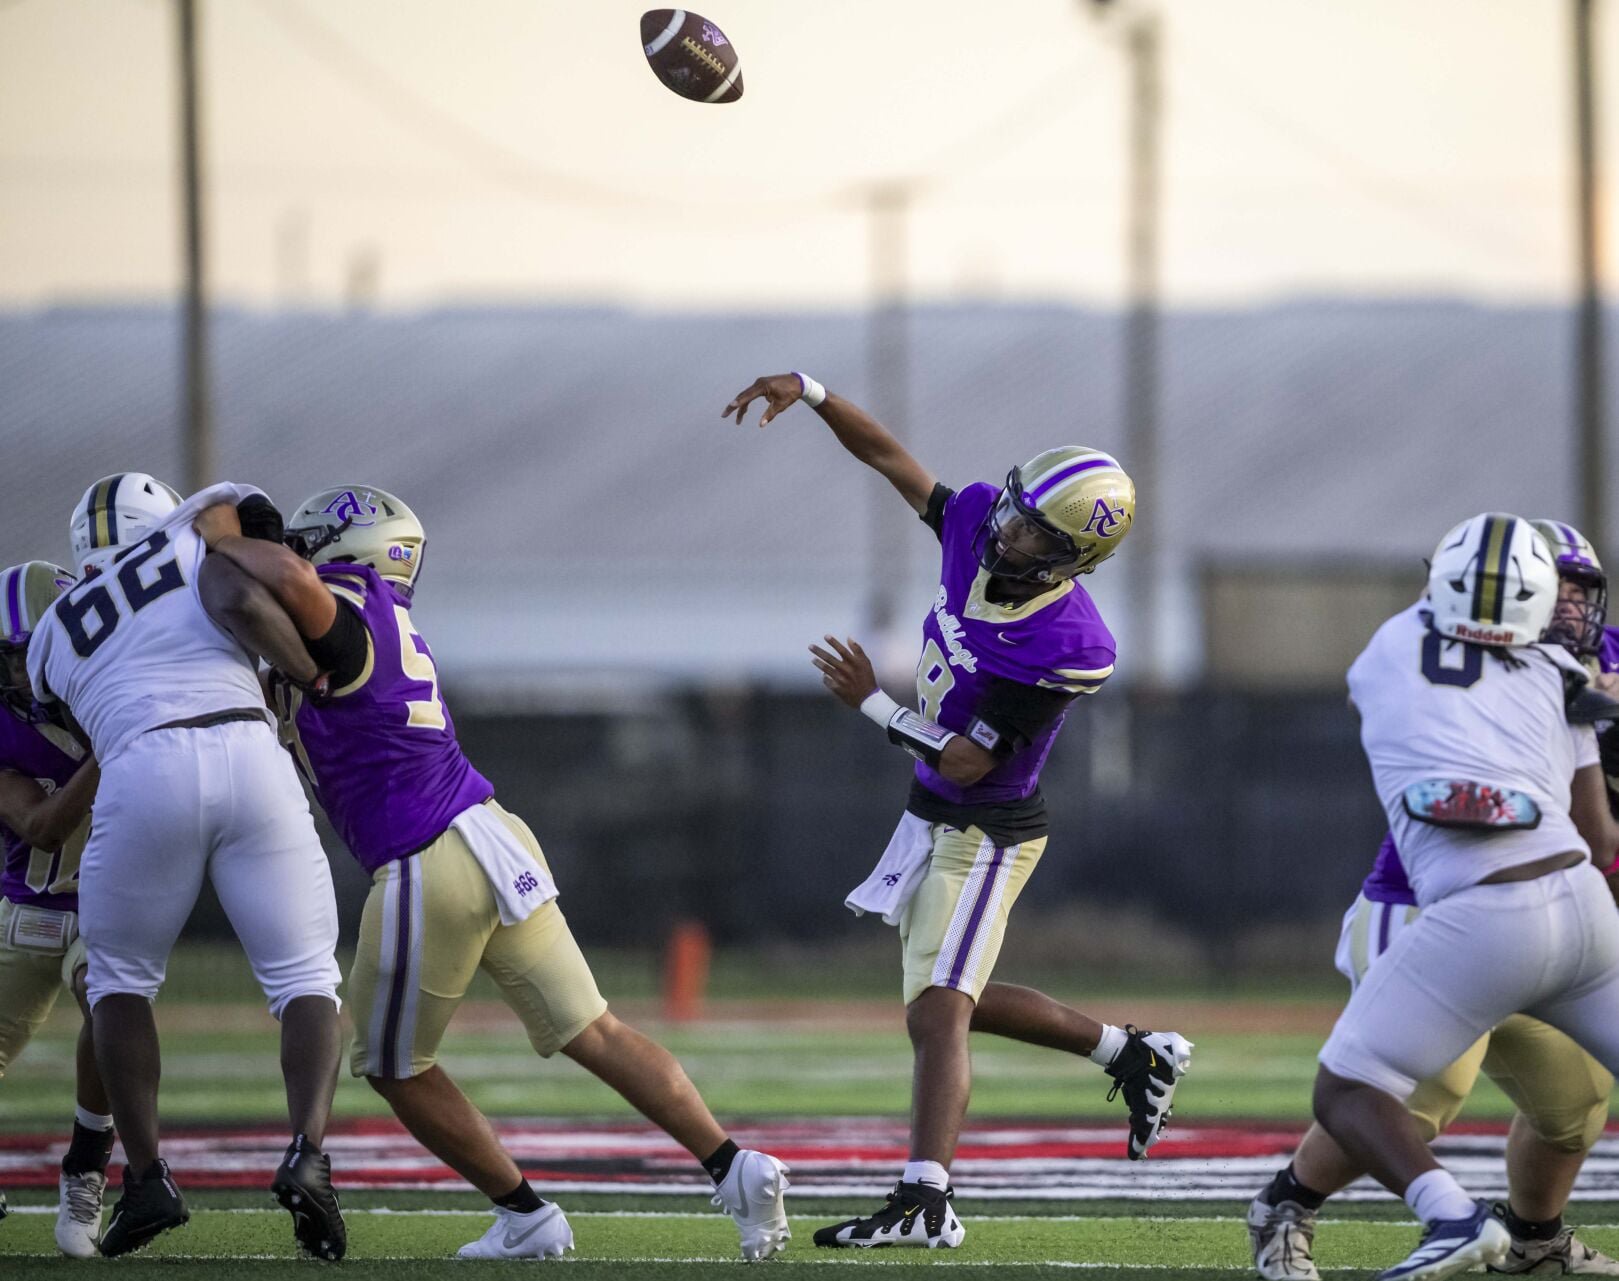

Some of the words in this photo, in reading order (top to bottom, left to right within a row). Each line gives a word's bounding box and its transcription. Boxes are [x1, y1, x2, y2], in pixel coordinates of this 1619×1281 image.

[1080, 496, 1126, 538] AC
[55, 529, 188, 658] 62
[1456, 624, 1514, 643] Riddell
[513, 871, 538, 898] #66
